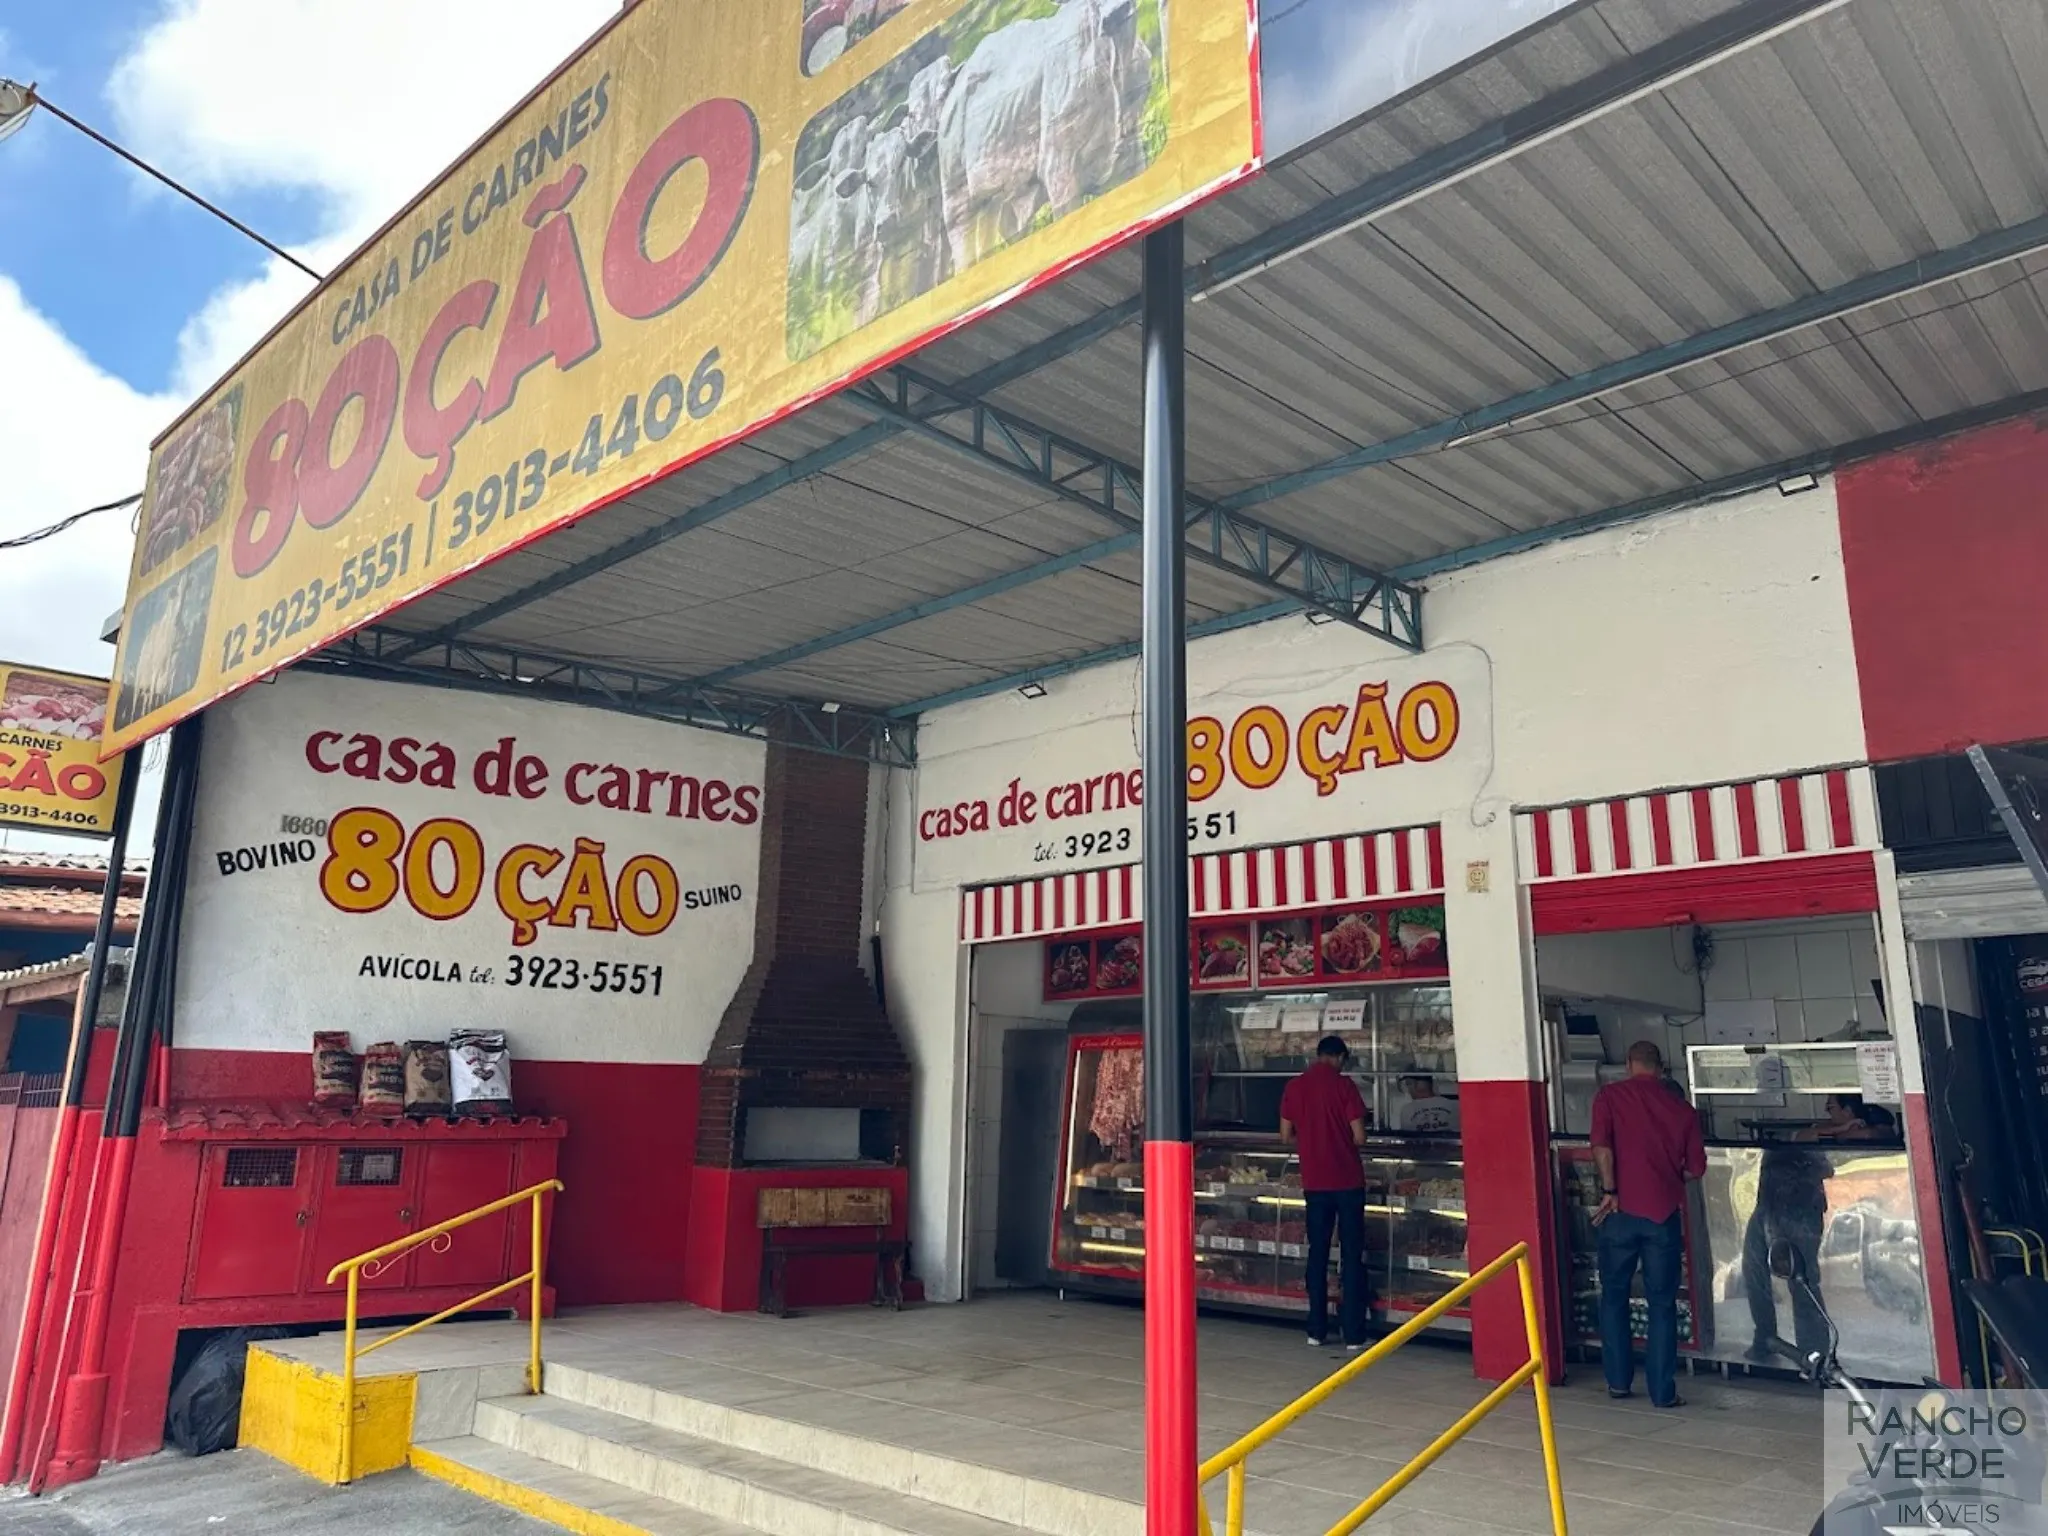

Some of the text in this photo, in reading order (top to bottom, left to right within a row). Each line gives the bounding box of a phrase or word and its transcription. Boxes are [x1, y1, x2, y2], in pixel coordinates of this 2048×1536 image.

[332, 71, 611, 345] CASA DE CARNES
[220, 346, 725, 673] 12 3923-5551 3913-4406
[0, 732, 63, 751] CARNES
[305, 730, 761, 825] casa de carnes
[0, 803, 99, 825] 3913-4406
[919, 800, 989, 841] casa
[998, 777, 1038, 828] de
[216, 838, 316, 877] BOVINO
[684, 883, 742, 910] SUINO
